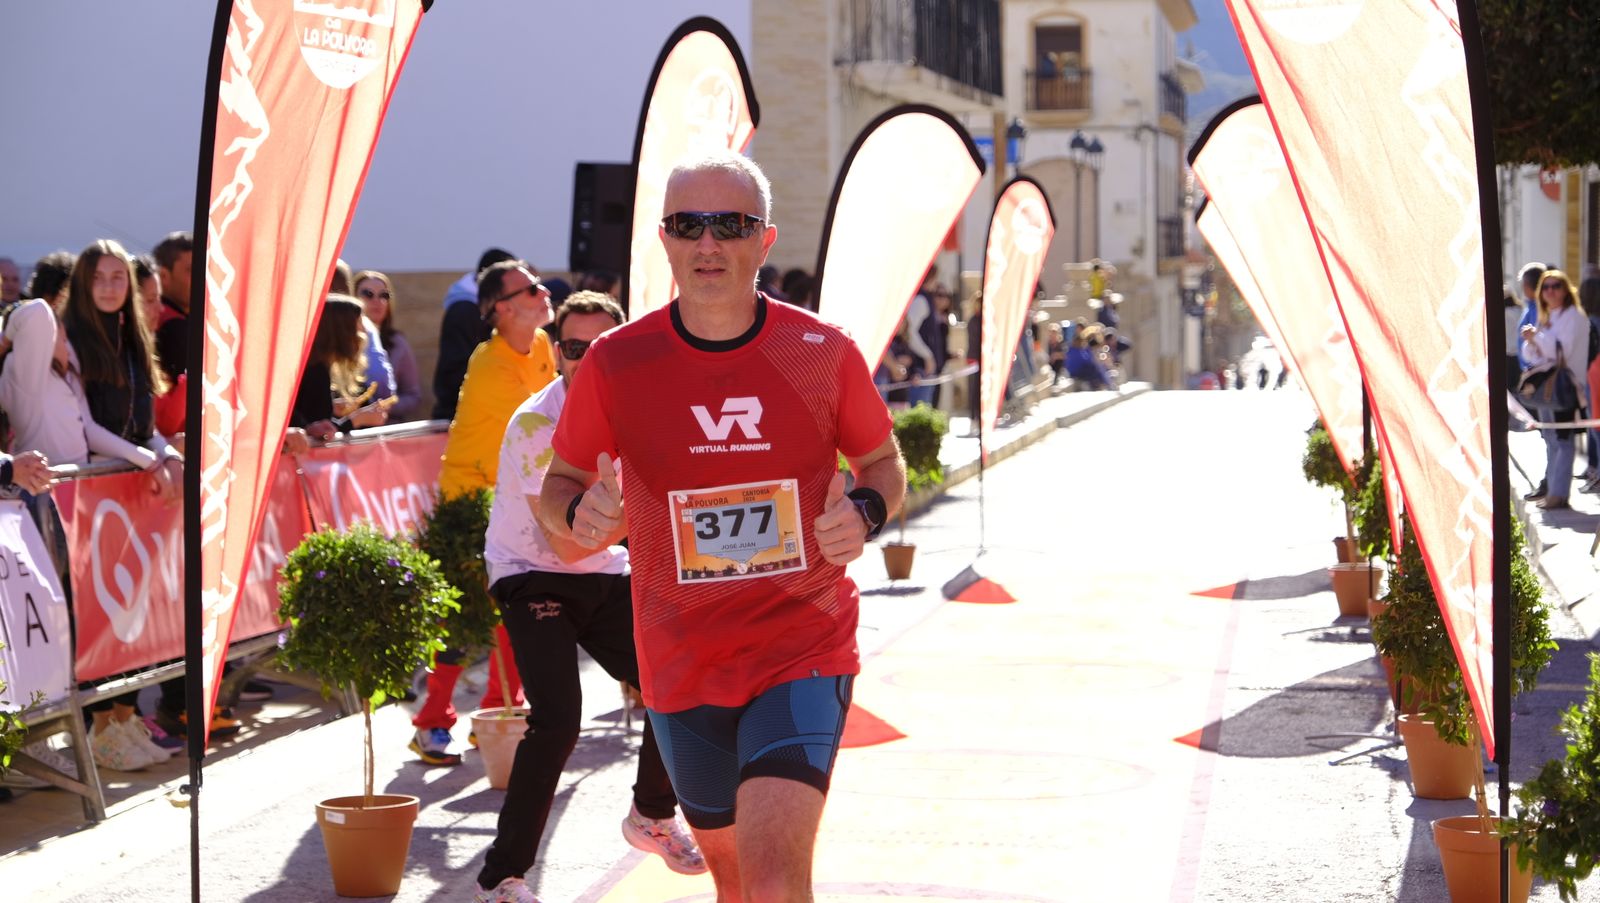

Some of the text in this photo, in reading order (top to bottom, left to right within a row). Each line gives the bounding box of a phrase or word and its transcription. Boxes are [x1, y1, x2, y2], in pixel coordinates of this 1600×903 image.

[303, 27, 319, 46] LA
[689, 442, 771, 454] VIRTUAL RUNNING
[695, 504, 773, 540] 377
